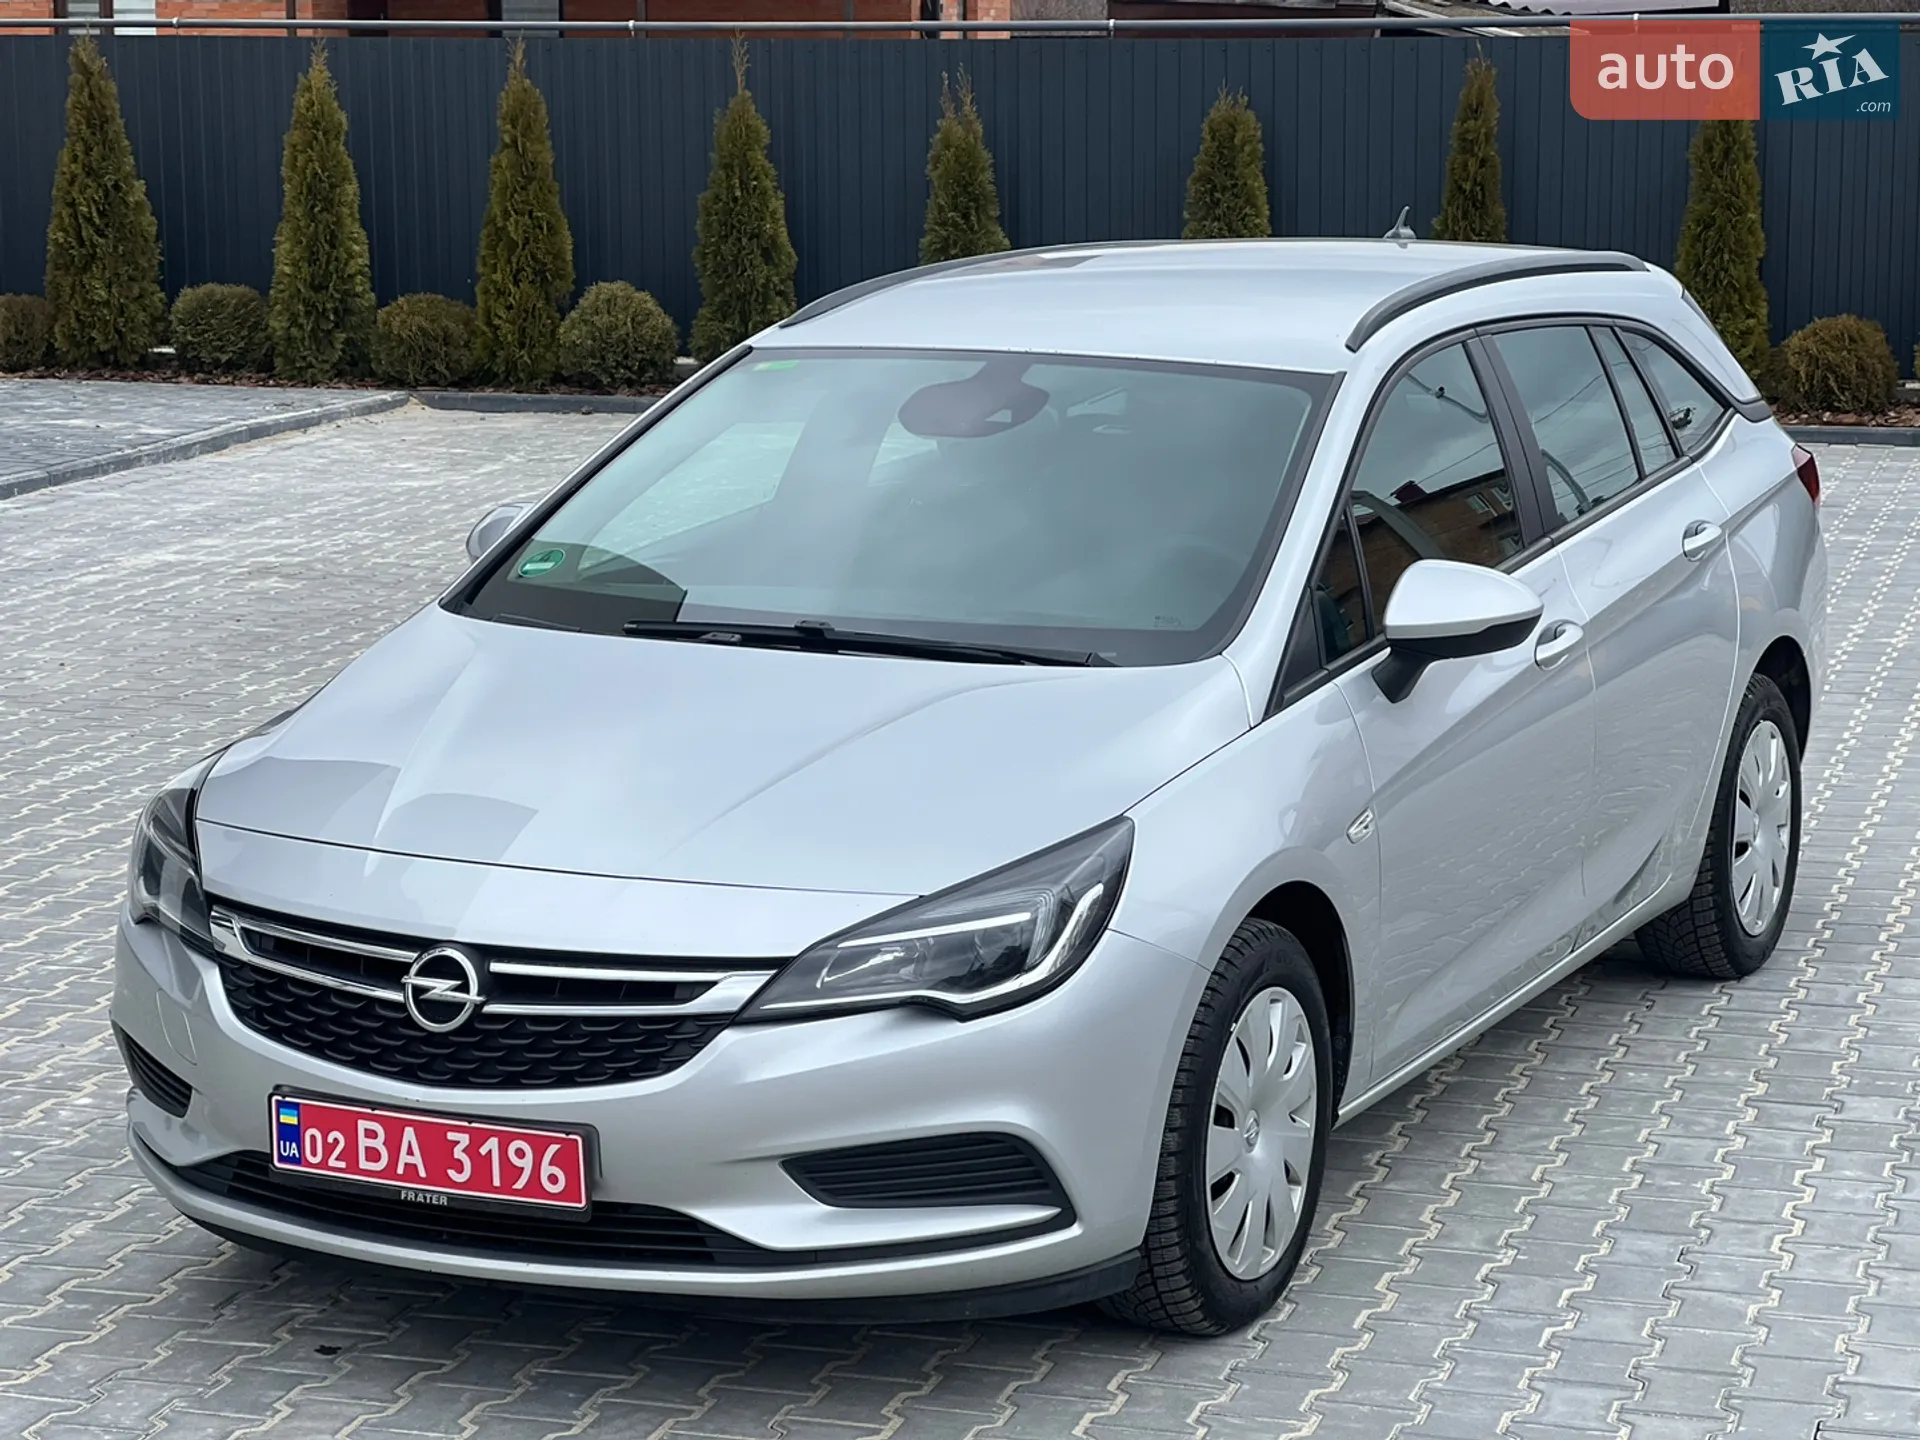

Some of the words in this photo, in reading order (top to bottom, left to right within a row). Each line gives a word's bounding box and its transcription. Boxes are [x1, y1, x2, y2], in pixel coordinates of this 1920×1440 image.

[280, 1140, 299, 1158] UA
[304, 1127, 346, 1169] 02
[357, 1119, 427, 1178] BA
[446, 1131, 566, 1194] 3196
[401, 1190, 448, 1206] FRATER
